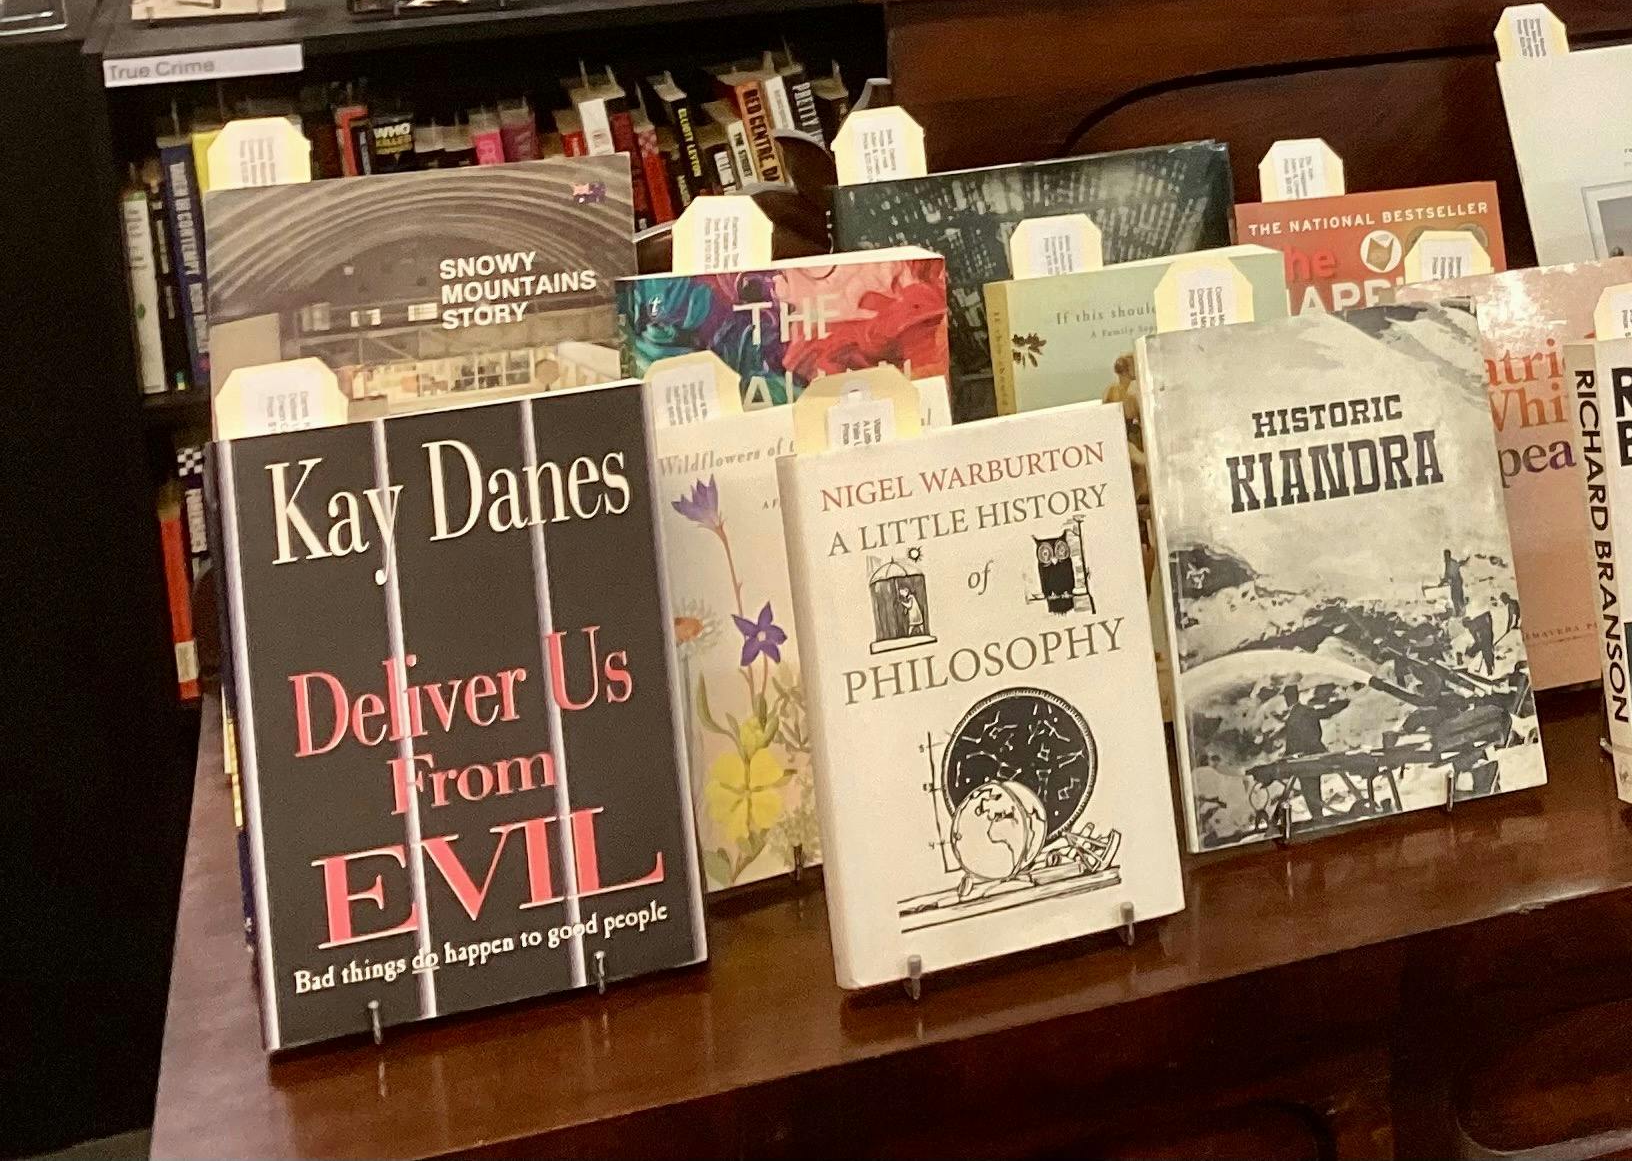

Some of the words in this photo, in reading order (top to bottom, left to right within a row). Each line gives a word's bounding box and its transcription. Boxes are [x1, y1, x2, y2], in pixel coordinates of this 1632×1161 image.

[108, 64, 150, 81] True
[155, 58, 216, 78] Crime
[1249, 223, 1282, 237] THE
[1290, 213, 1375, 232] NATIONAL
[1382, 202, 1488, 224] BESTSELLER
[440, 250, 536, 280] SNOWY
[440, 269, 598, 305] MOUNTAINS
[1284, 245, 1337, 280] he
[441, 300, 530, 330] STORY
[732, 295, 834, 346] THE
[1056, 311, 1069, 325] If
[1076, 309, 1103, 322] this
[1251, 394, 1404, 439] HISTORIC
[657, 447, 760, 477] Wildflowers
[768, 437, 784, 457] of
[820, 473, 914, 513] NIGEL
[918, 440, 1106, 494] WARBURTON
[1226, 430, 1444, 514] KIANDRA
[265, 455, 405, 586] Kay
[421, 438, 632, 544] Danes
[828, 530, 850, 557] A
[858, 508, 969, 552] LITTLE
[975, 483, 1109, 530] HISTORY
[1574, 369, 1609, 532] RICHARD
[1593, 543, 1629, 723] BRANSON
[967, 558, 995, 596] of
[842, 616, 1126, 706] PHILOSOPHY
[289, 654, 527, 759] Deliver
[544, 625, 633, 711] Us
[388, 749, 557, 815] From
[312, 805, 666, 950] EVIL
[294, 961, 336, 995] Bad
[341, 952, 407, 989] things
[411, 947, 440, 974] do
[444, 936, 515, 973] happen
[520, 929, 543, 949] to
[547, 911, 598, 951] good
[604, 899, 668, 939] people
